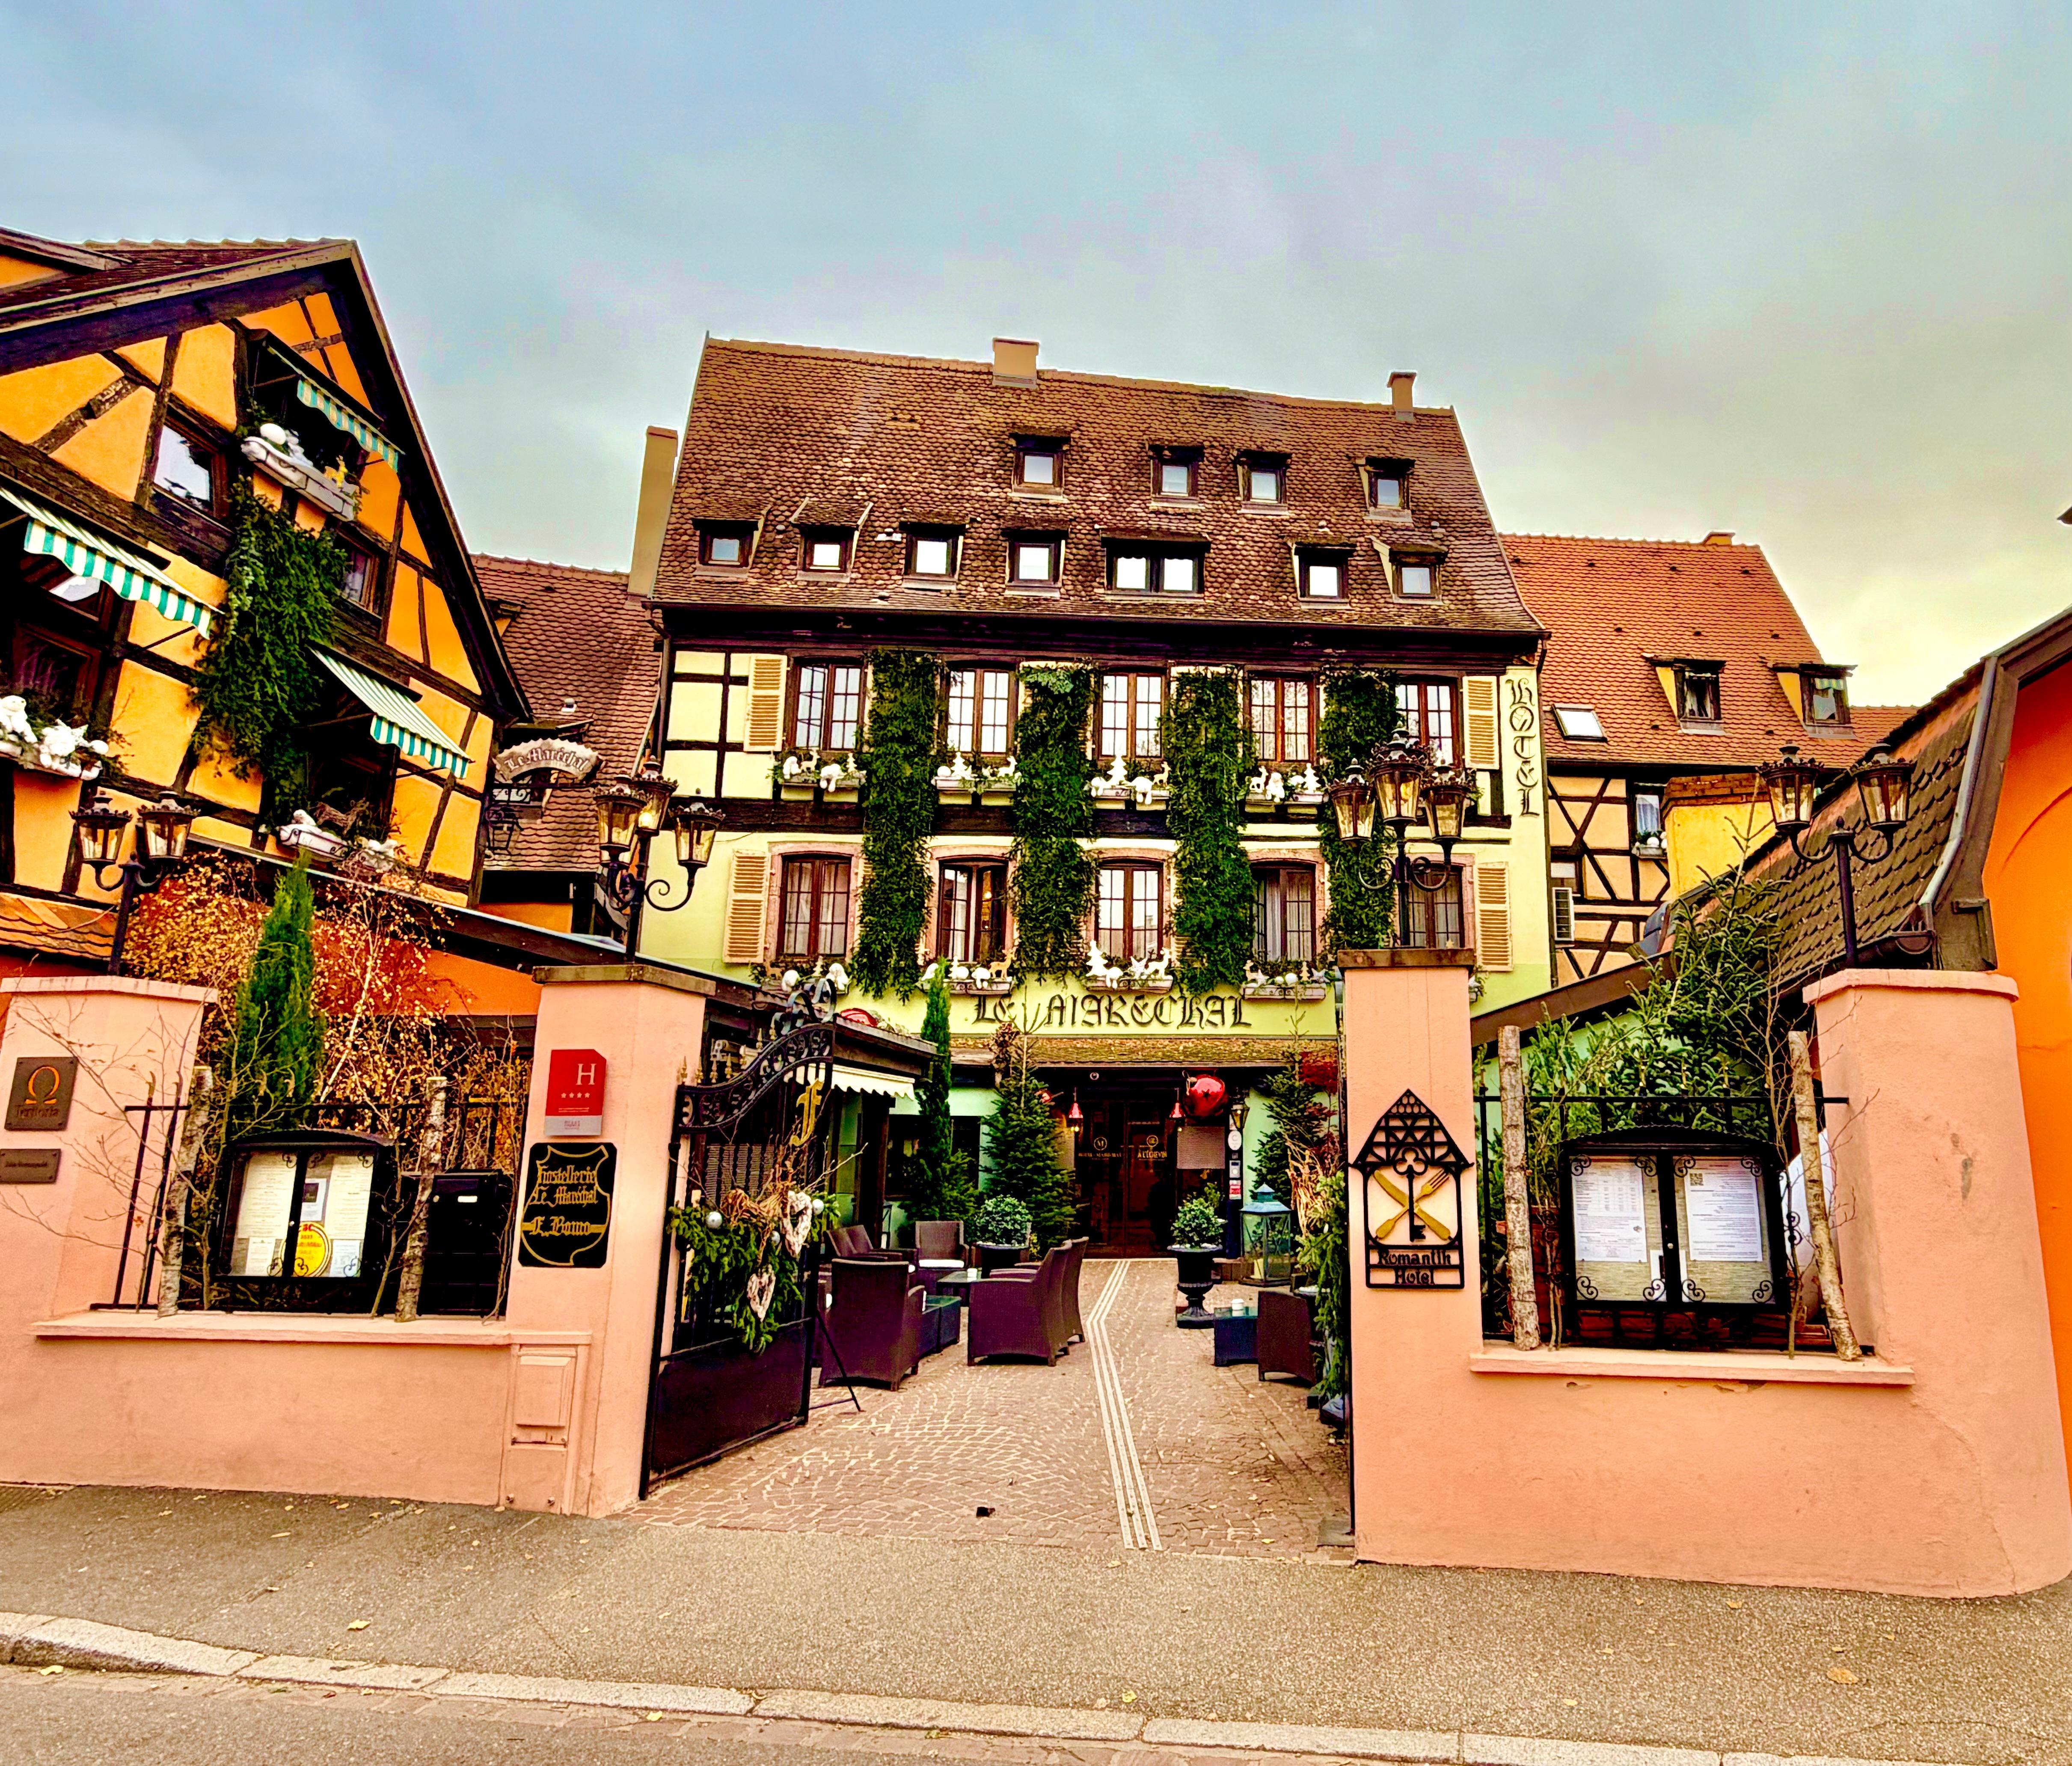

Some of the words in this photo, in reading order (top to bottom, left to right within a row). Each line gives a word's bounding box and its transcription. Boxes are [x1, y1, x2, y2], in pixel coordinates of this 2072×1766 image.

[504, 756, 525, 771] Le
[527, 747, 589, 771] Maréchal
[971, 994, 1016, 1025] LE
[576, 1063, 597, 1085] H
[1394, 1268, 1434, 1285] Hotel
